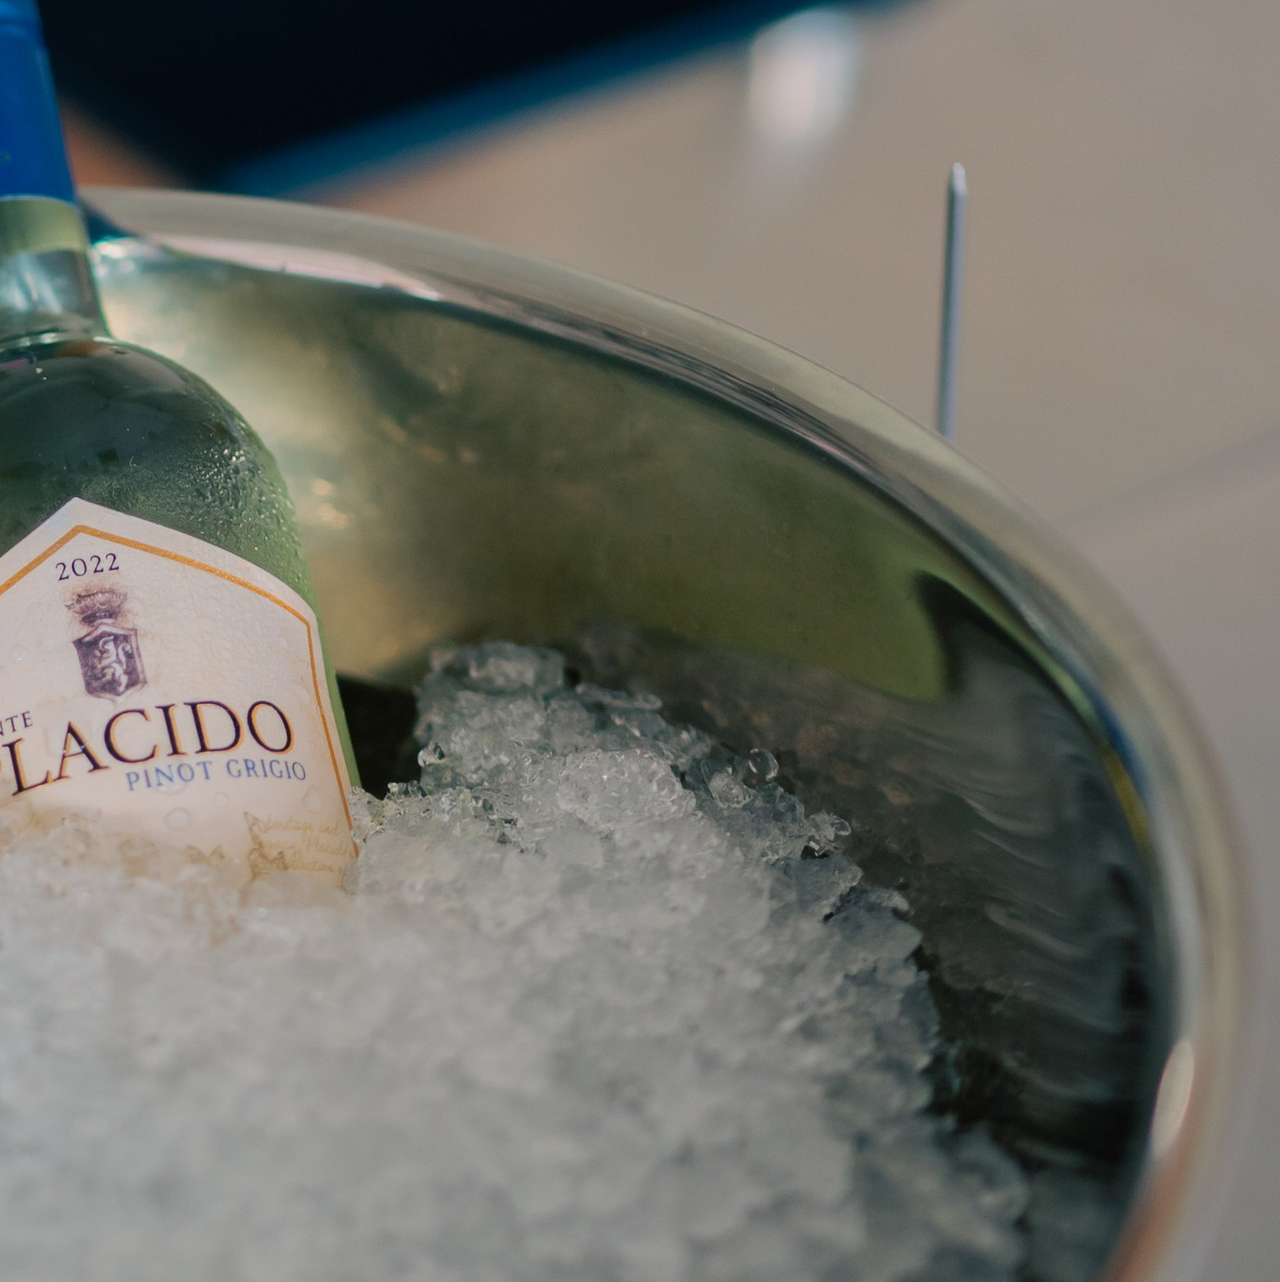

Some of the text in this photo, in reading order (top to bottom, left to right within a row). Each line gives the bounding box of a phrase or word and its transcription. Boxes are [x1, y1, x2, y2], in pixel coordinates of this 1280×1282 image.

[55, 552, 121, 582] 2022
[125, 758, 307, 792] PINOT GRIGIO
